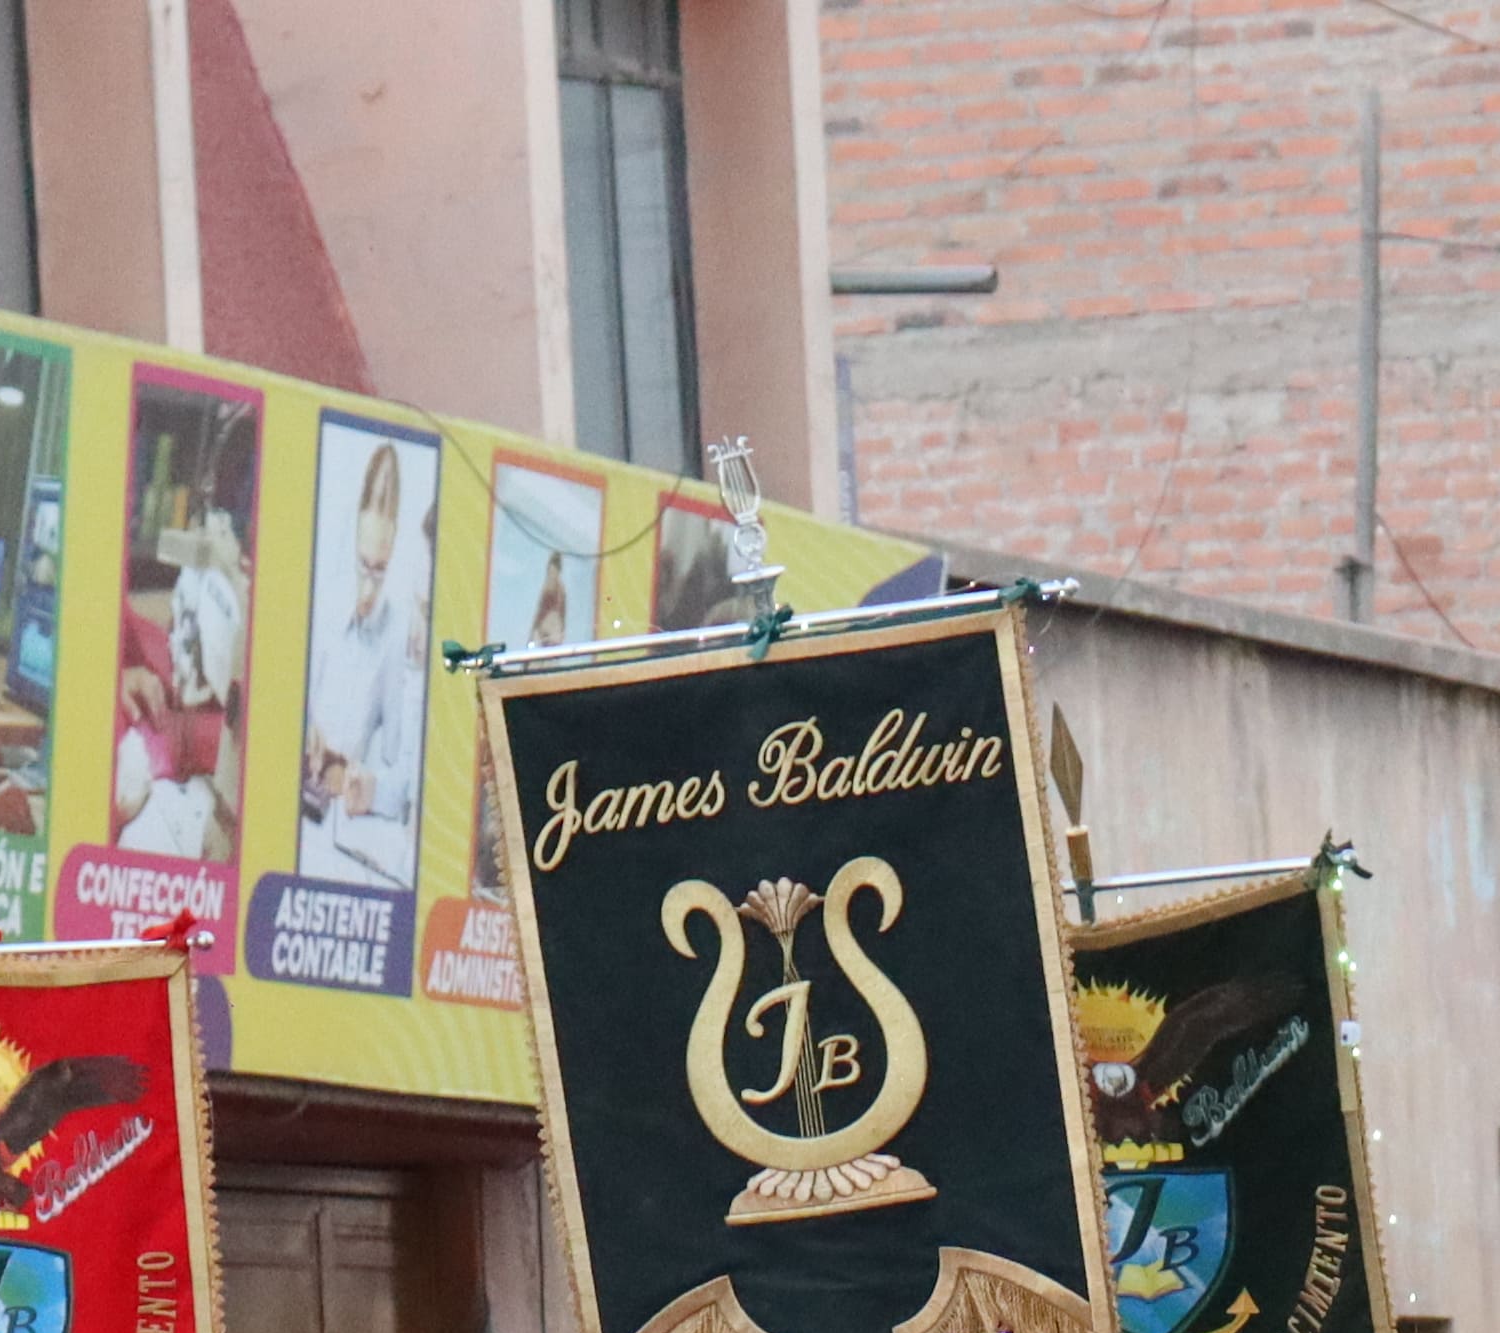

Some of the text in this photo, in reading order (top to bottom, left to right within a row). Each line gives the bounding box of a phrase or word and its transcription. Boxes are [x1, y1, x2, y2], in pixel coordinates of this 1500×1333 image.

[533, 707, 1002, 871] James Baldwin
[29, 853, 46, 893] E
[77, 861, 225, 920] CONFECCIÓN
[274, 886, 395, 943] ASISTENTE
[272, 931, 385, 986] CONTABLE
